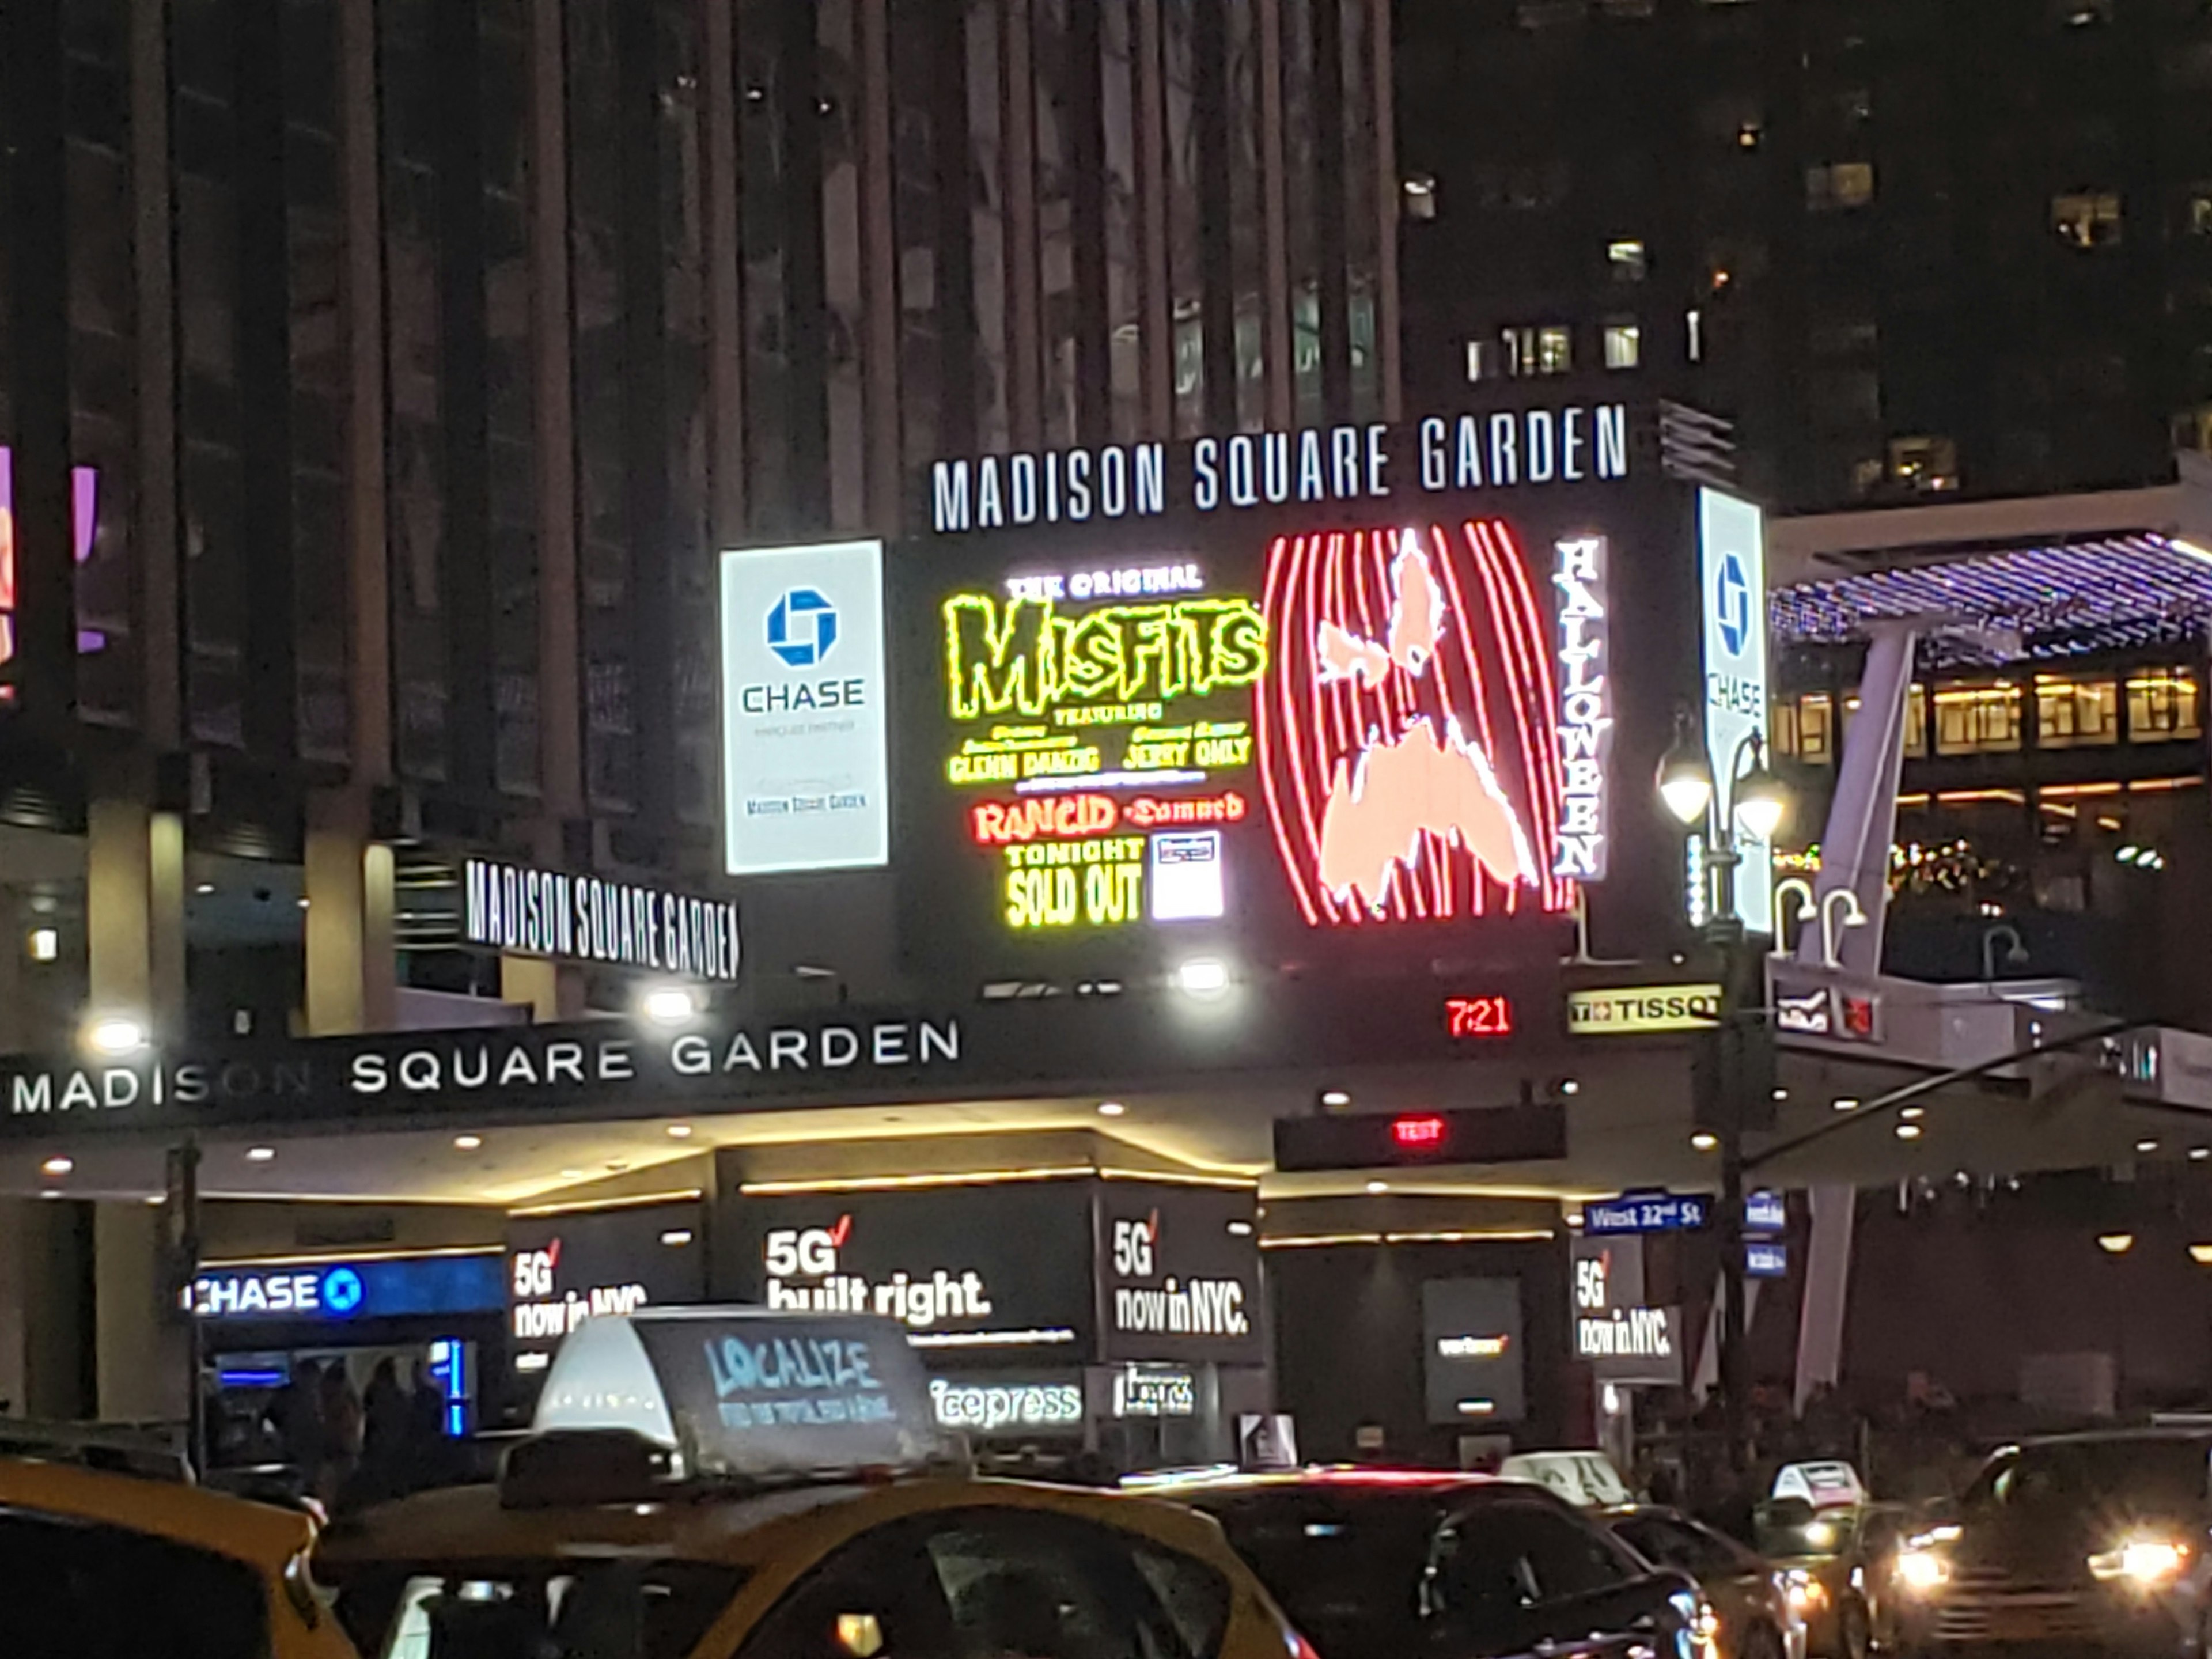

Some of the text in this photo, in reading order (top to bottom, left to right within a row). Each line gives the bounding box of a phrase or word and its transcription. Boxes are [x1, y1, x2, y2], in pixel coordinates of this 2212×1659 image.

[933, 404, 1628, 532] MADISON SQUARE GARDEN
[1007, 564, 1202, 598] THE ORIGINAL
[743, 679, 865, 713] CHASE
[1708, 673, 1761, 718] CHASE
[1005, 837, 1145, 866] TONIGHT
[1006, 863, 1142, 927] SOLD OUT
[466, 859, 740, 980] MADISON SQUARE GARDEN
[1446, 997, 1509, 1037] 7:21
[12, 1021, 959, 1113] MADISON SQUARE GARDEN
[1591, 1207, 1638, 1228] West
[1680, 1202, 1702, 1224] St
[766, 1229, 836, 1275] 5G
[1115, 1221, 1153, 1276] 5G
[183, 1274, 321, 1313] CHASE
[514, 1250, 552, 1296] 5G
[1577, 1259, 1605, 1308] 5G
[874, 1270, 992, 1325] right.
[1115, 1277, 1249, 1334] now in NYC.
[514, 1304, 566, 1338] now
[1579, 1308, 1671, 1355] now in NYC.
